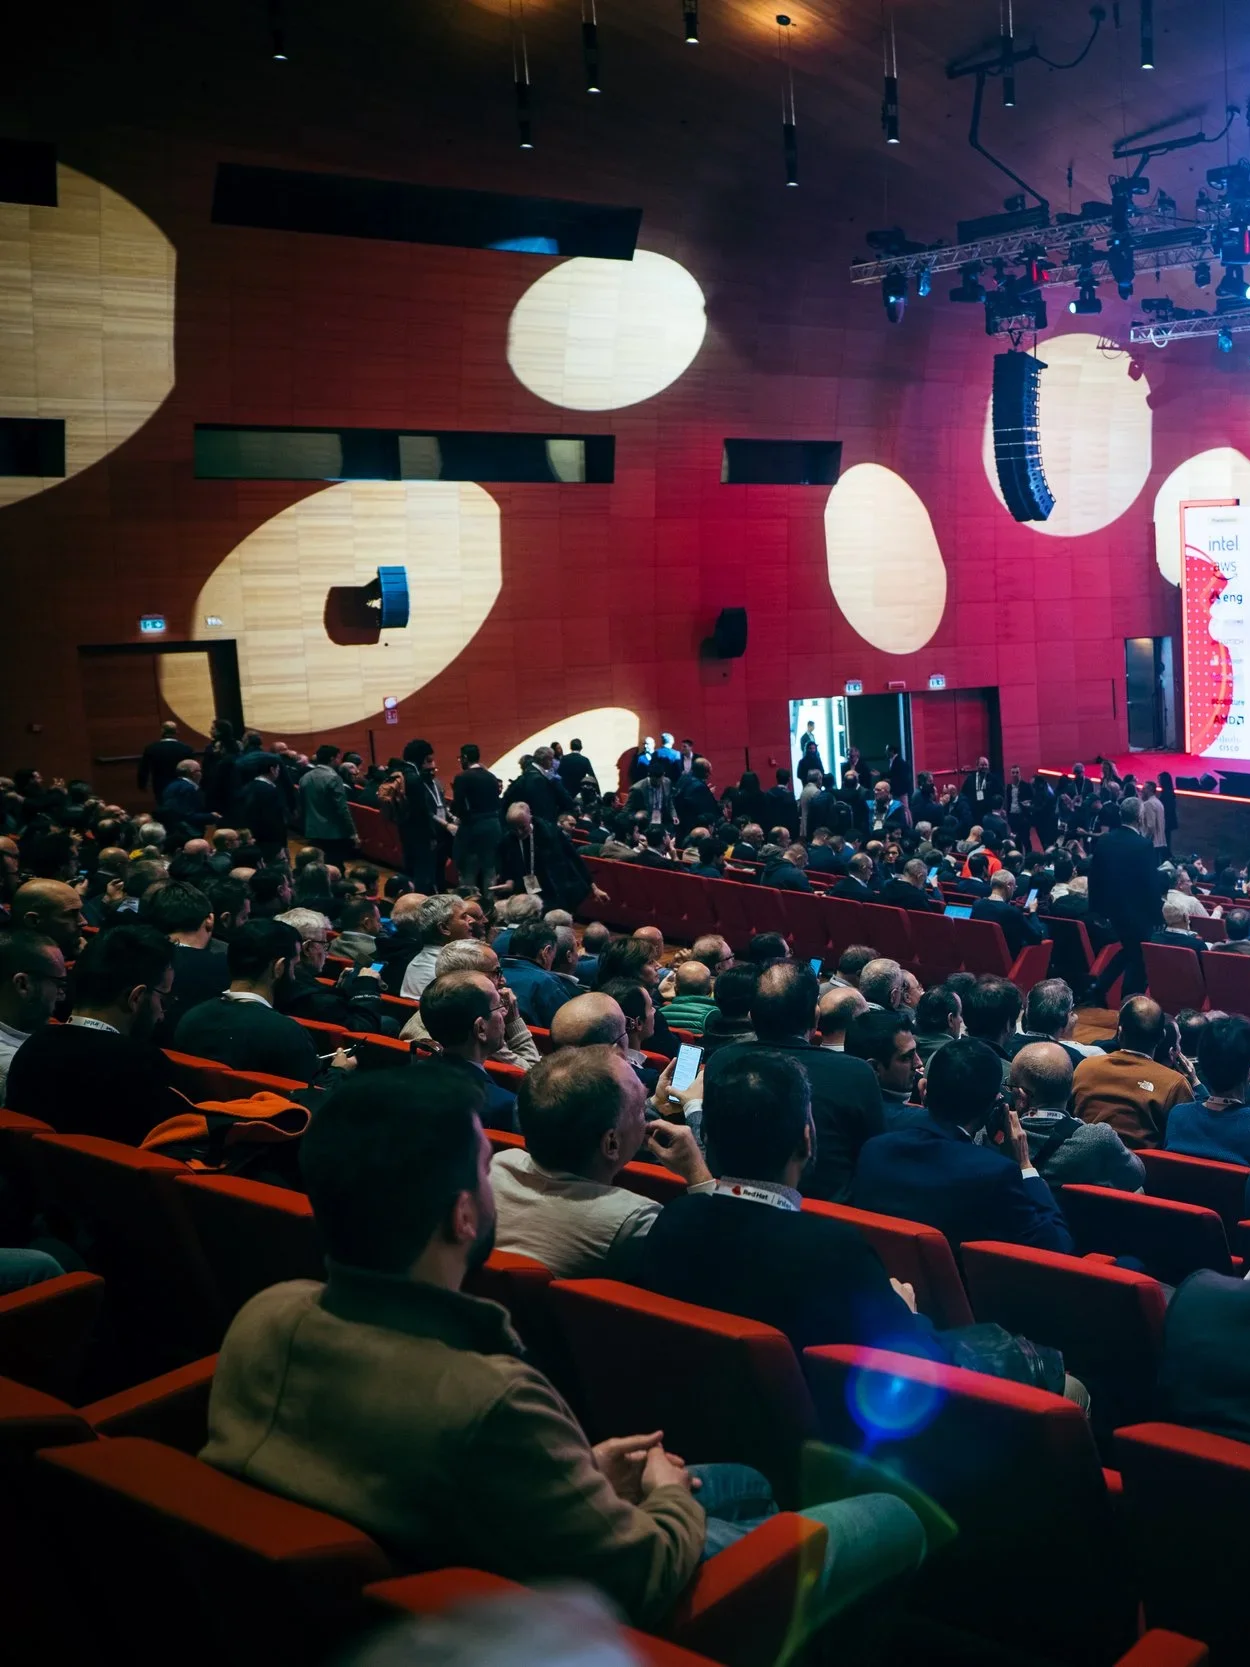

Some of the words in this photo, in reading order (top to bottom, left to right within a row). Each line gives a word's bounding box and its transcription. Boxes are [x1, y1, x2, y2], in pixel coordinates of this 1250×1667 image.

[1208, 534, 1239, 552] intel
[1213, 561, 1237, 573] aws
[1223, 593, 1244, 606] eng
